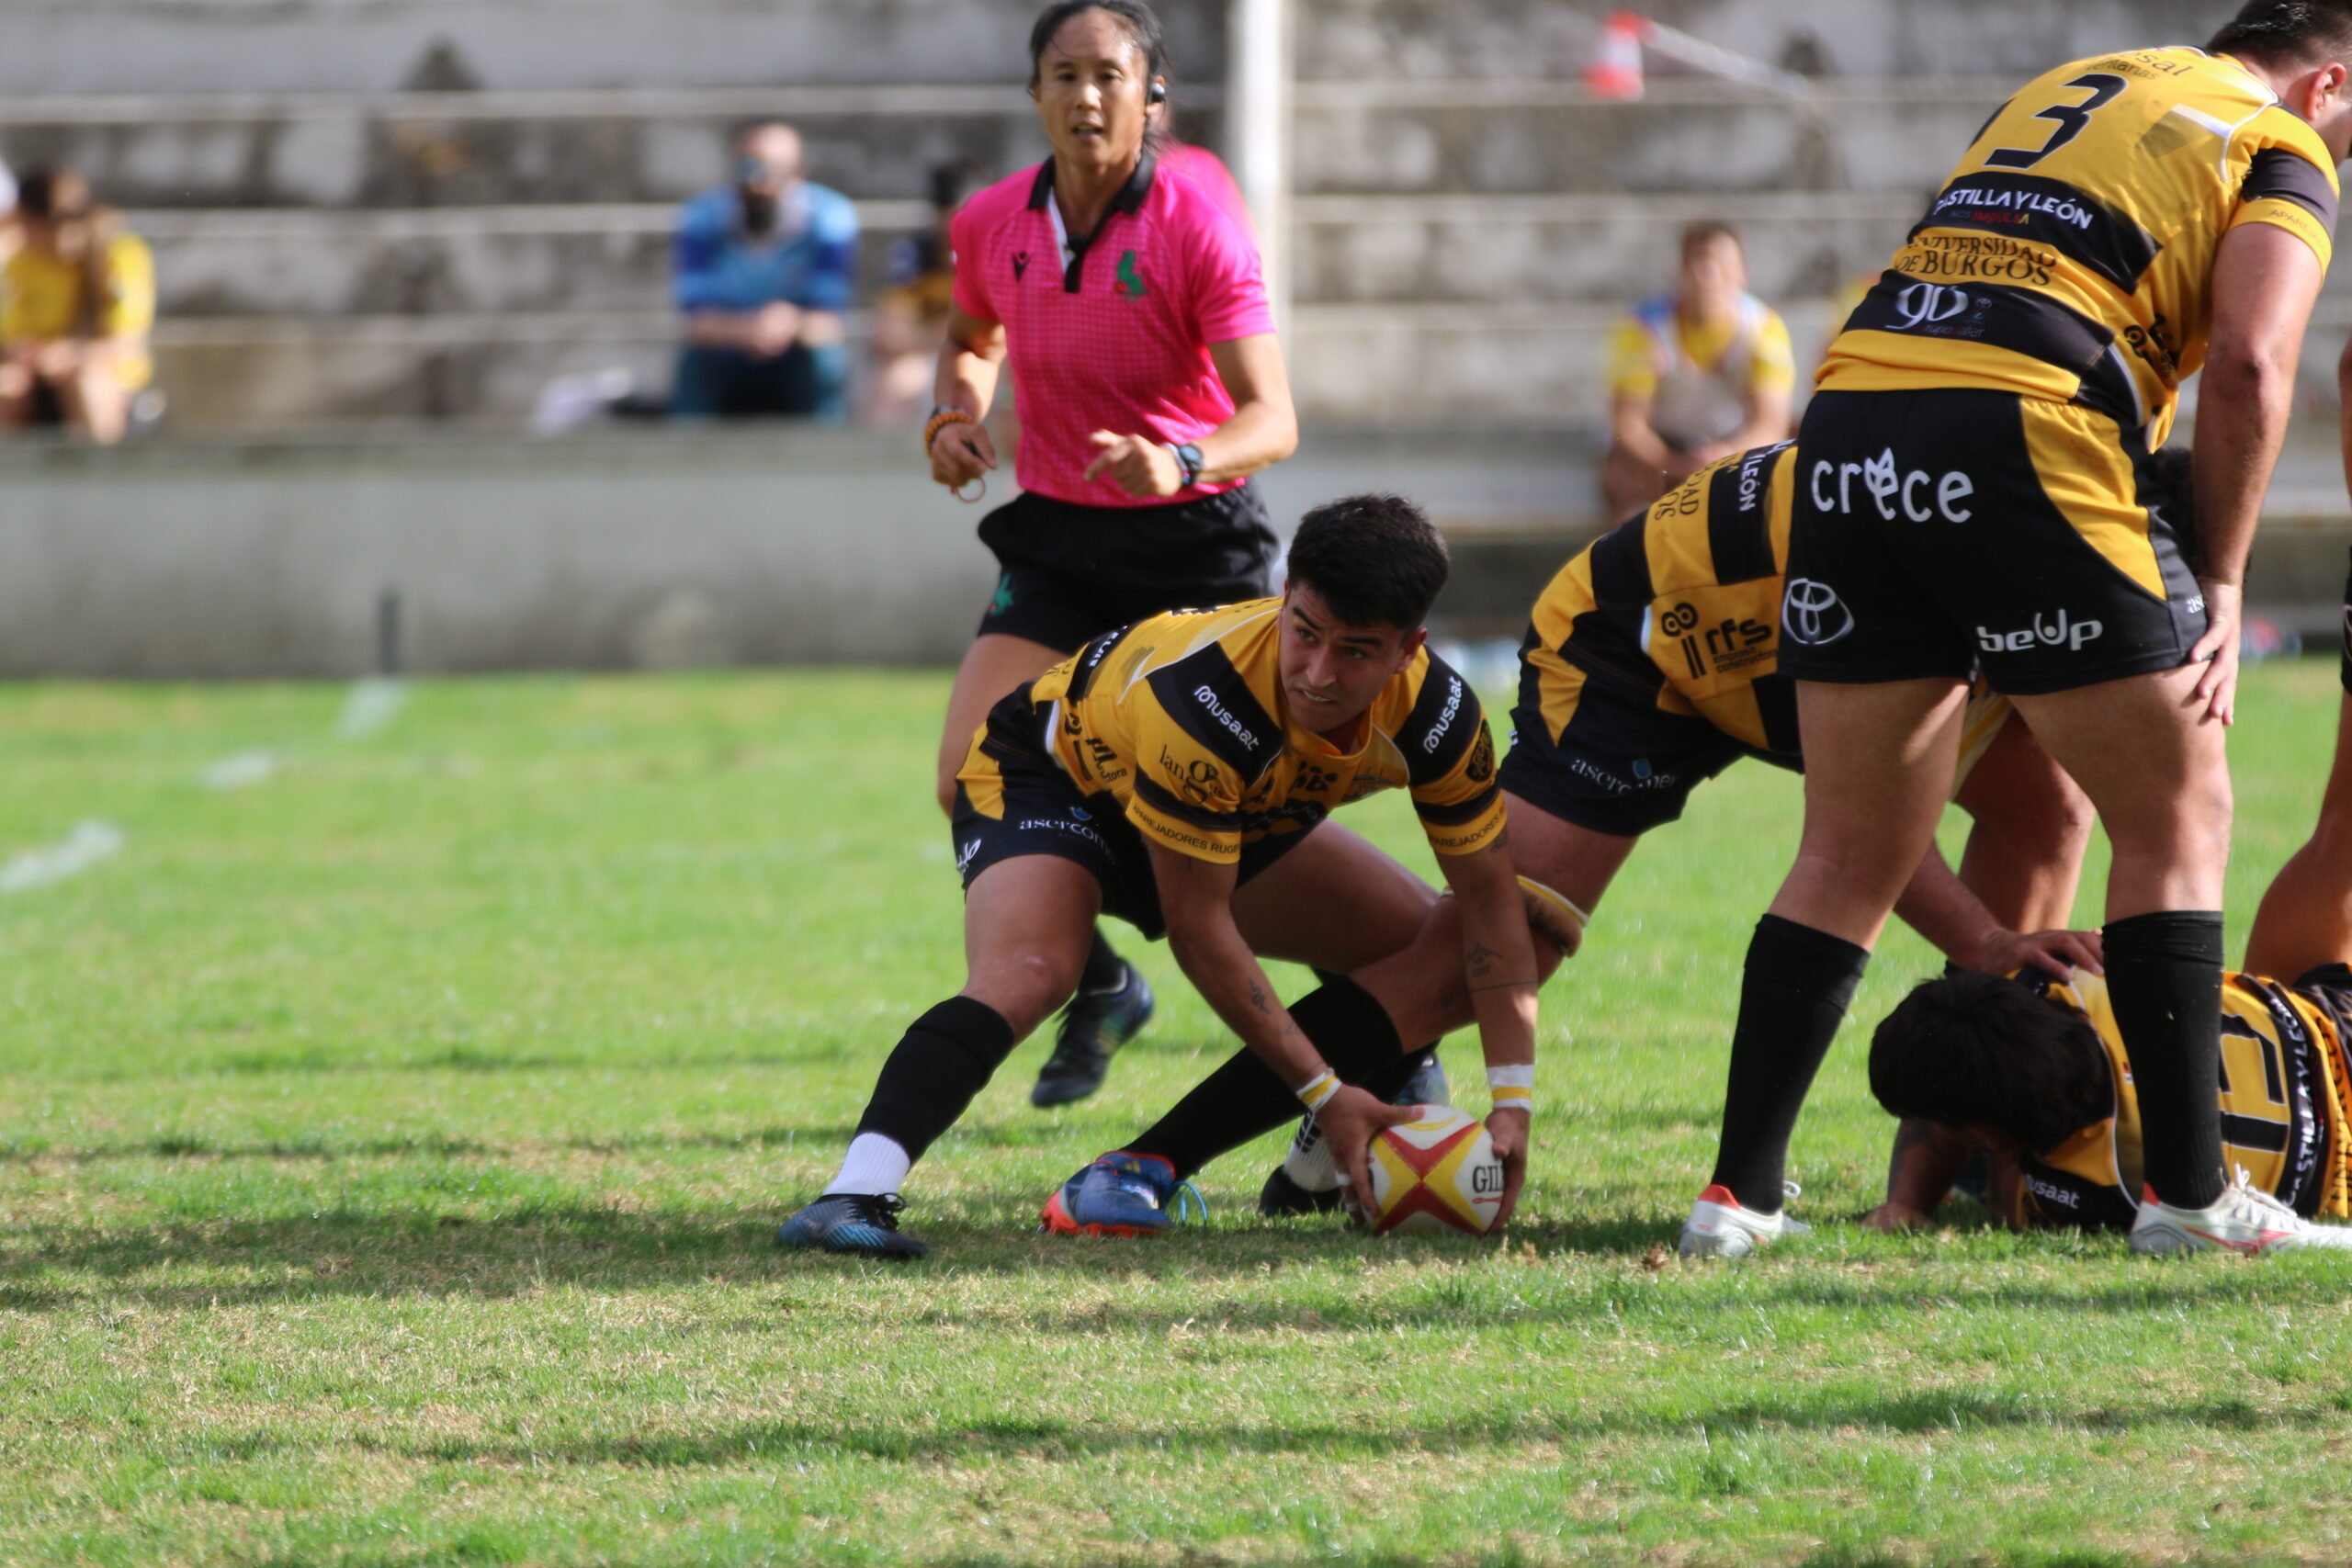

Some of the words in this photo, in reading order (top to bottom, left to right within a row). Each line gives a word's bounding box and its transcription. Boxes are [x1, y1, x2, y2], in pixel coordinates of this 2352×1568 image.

[1983, 73, 2128, 170] 3
[1919, 249, 2051, 286] BURGOS
[1811, 447, 1974, 524] crece
[2026, 1174, 2081, 1209] usaat
